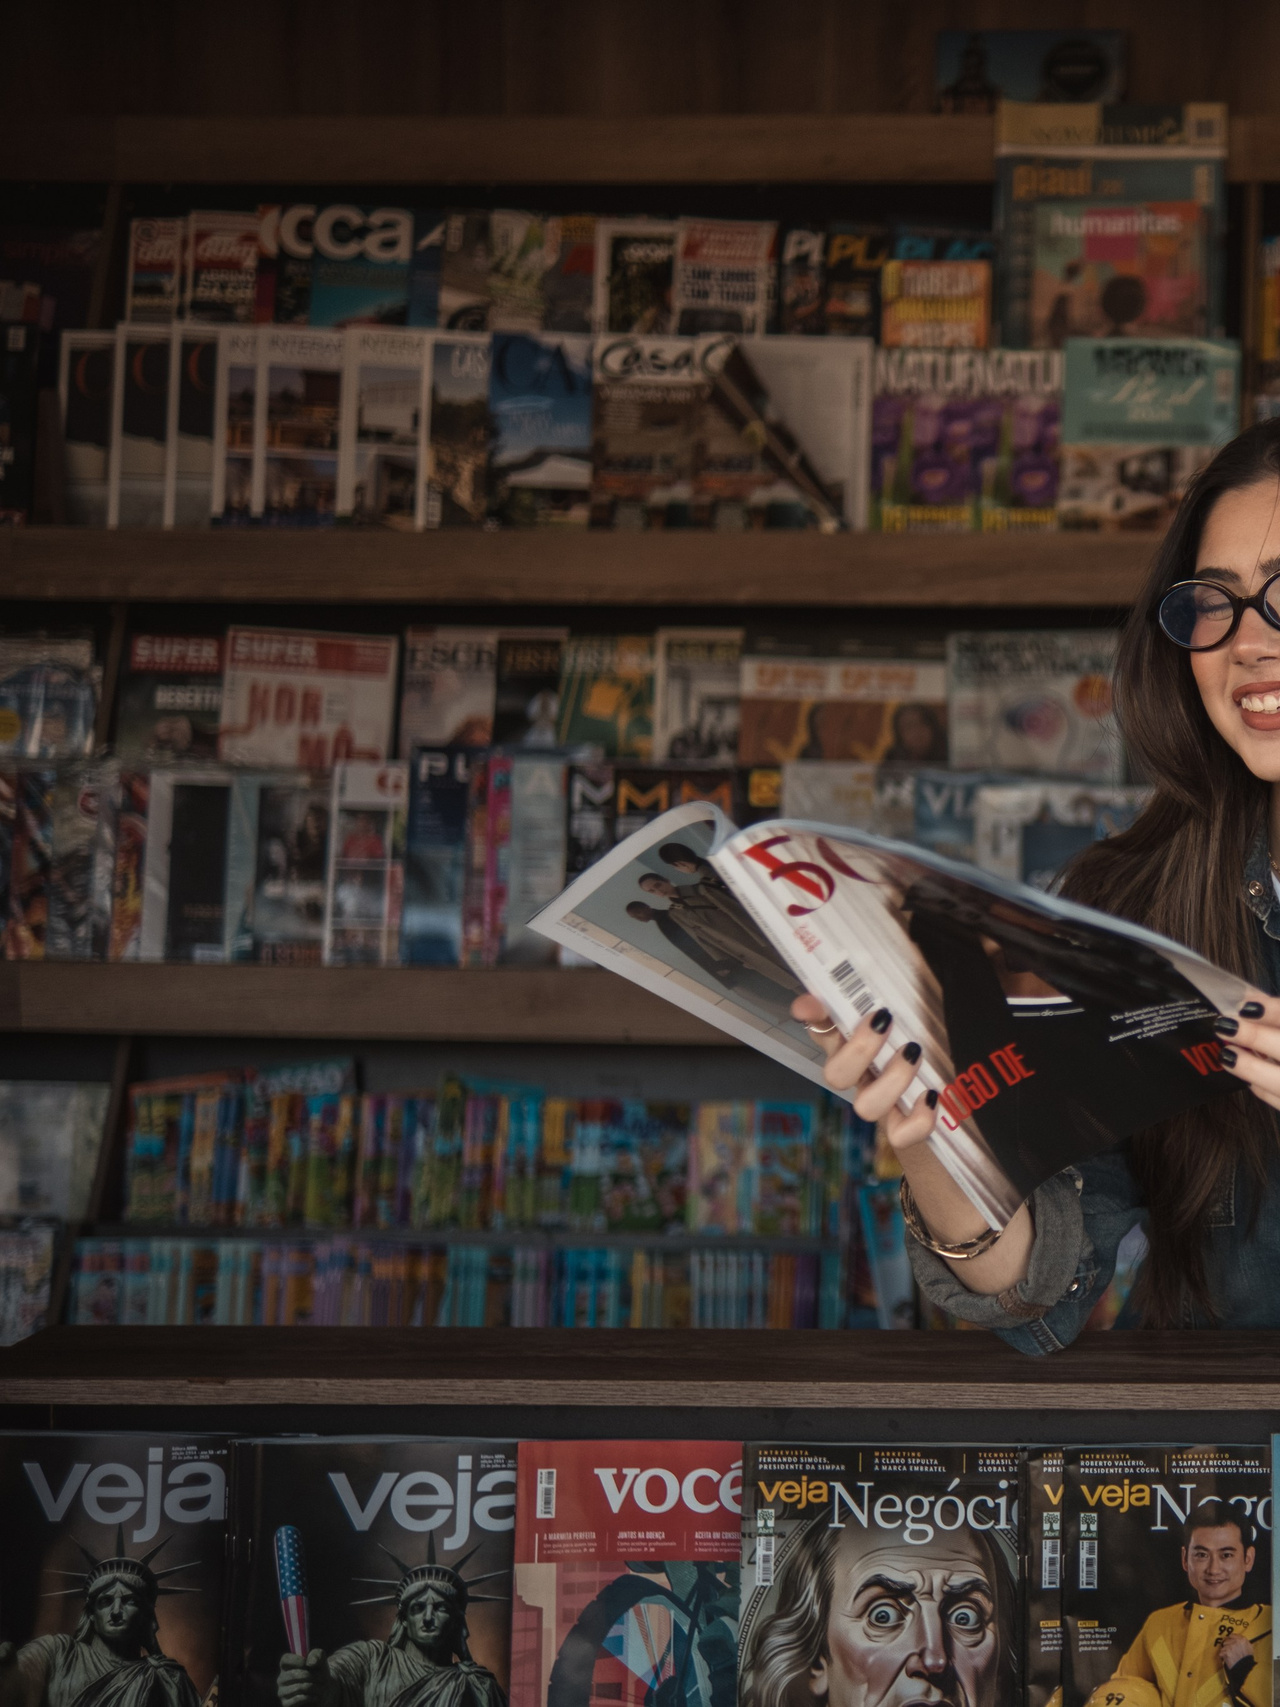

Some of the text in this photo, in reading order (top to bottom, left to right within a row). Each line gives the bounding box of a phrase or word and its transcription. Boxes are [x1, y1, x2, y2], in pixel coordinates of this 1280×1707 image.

[937, 1043, 1036, 1130] JOGO DE
[874, 1450, 922, 1458] MARKETING
[758, 1455, 830, 1465] FERNANDO SIMÕES,
[881, 1457, 906, 1465] CLARO
[985, 1458, 1010, 1466] BRASIL
[1114, 1458, 1147, 1468] VALÉRIO,
[1208, 1459, 1243, 1467] RECORDE,
[1244, 1459, 1260, 1467] MAS
[758, 1463, 804, 1471] PRESIDENTE
[909, 1465, 947, 1473] EMBRATEL
[23, 1447, 228, 1543] veja
[757, 1475, 829, 1510] veja
[1080, 1478, 1150, 1513] veja
[328, 1455, 517, 1551] veja
[1220, 1614, 1250, 1629] Pede
[1218, 1625, 1234, 1637] 99
[1105, 1692, 1126, 1706] 99
